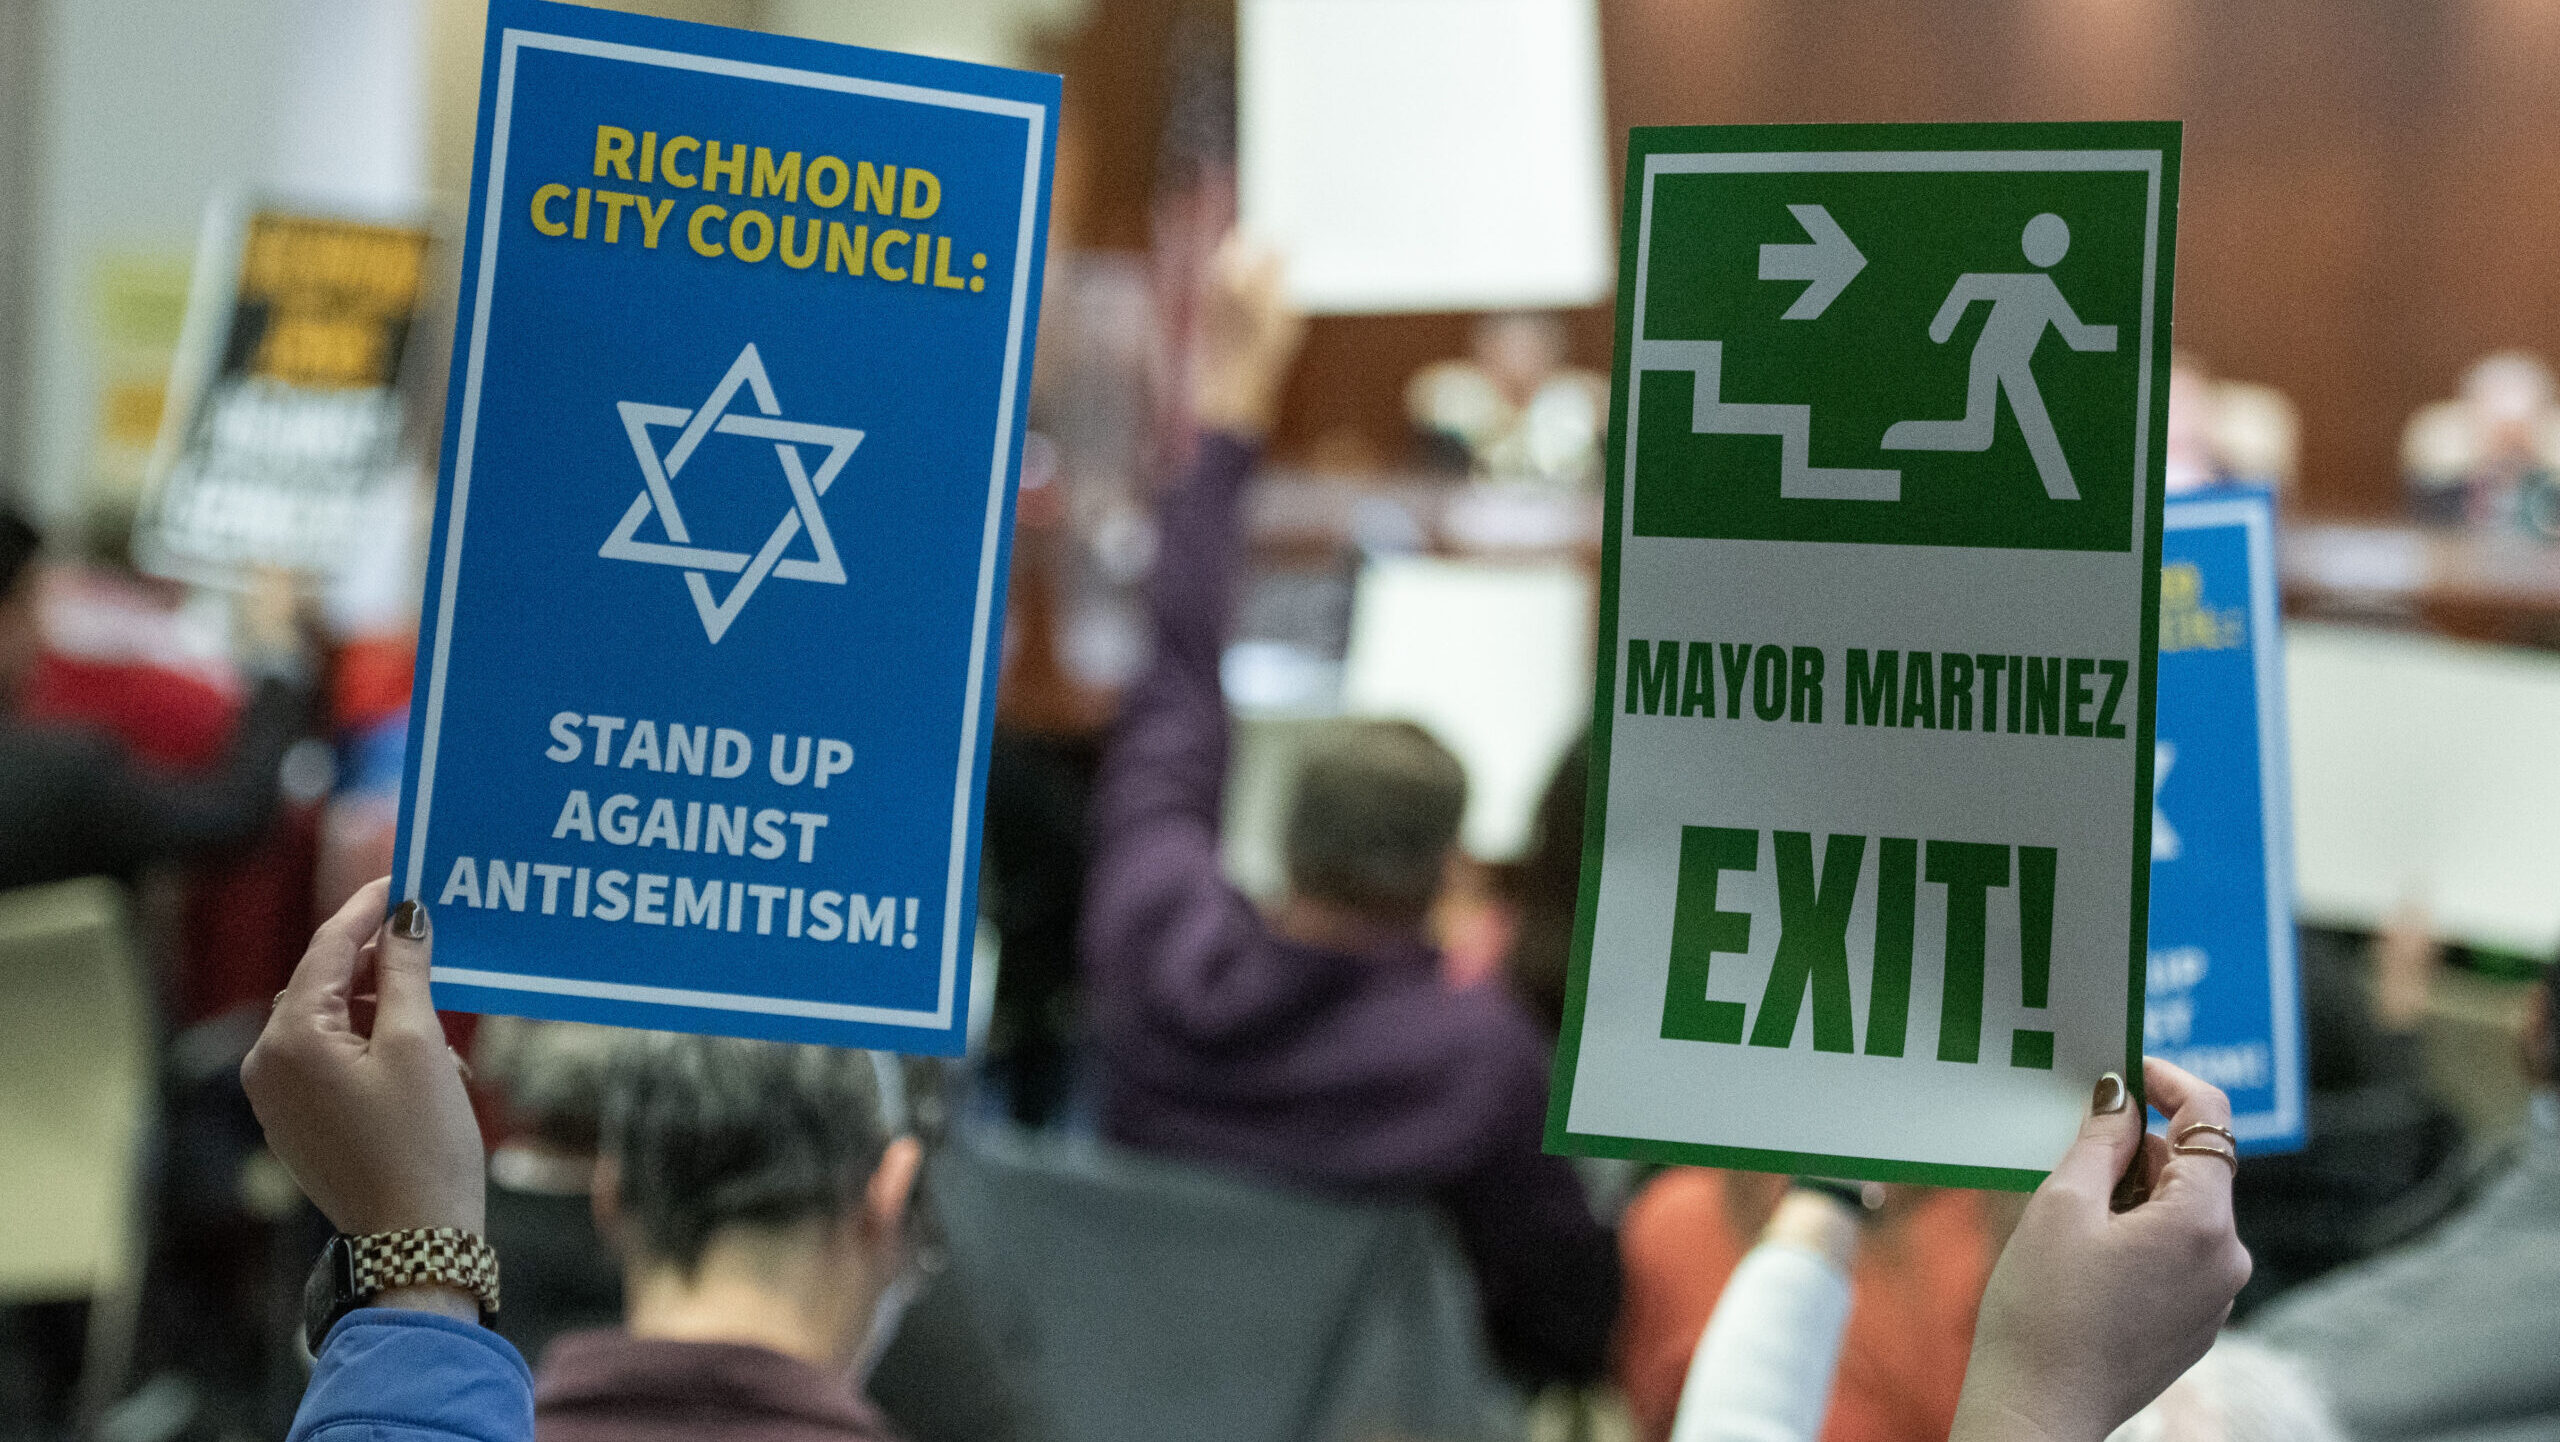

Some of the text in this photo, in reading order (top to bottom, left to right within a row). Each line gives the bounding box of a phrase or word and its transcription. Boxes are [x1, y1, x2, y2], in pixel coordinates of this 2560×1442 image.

[593, 125, 942, 221] RICHMOND
[530, 183, 987, 293] CITY COUNCIL:
[1624, 638, 2130, 740] MAYOR MARTINEZ
[545, 711, 854, 789] STAND UP
[552, 790, 829, 864] AGAINST
[439, 856, 919, 950] ANTISEMITISM!
[1659, 824, 2058, 1071] EXIT!
